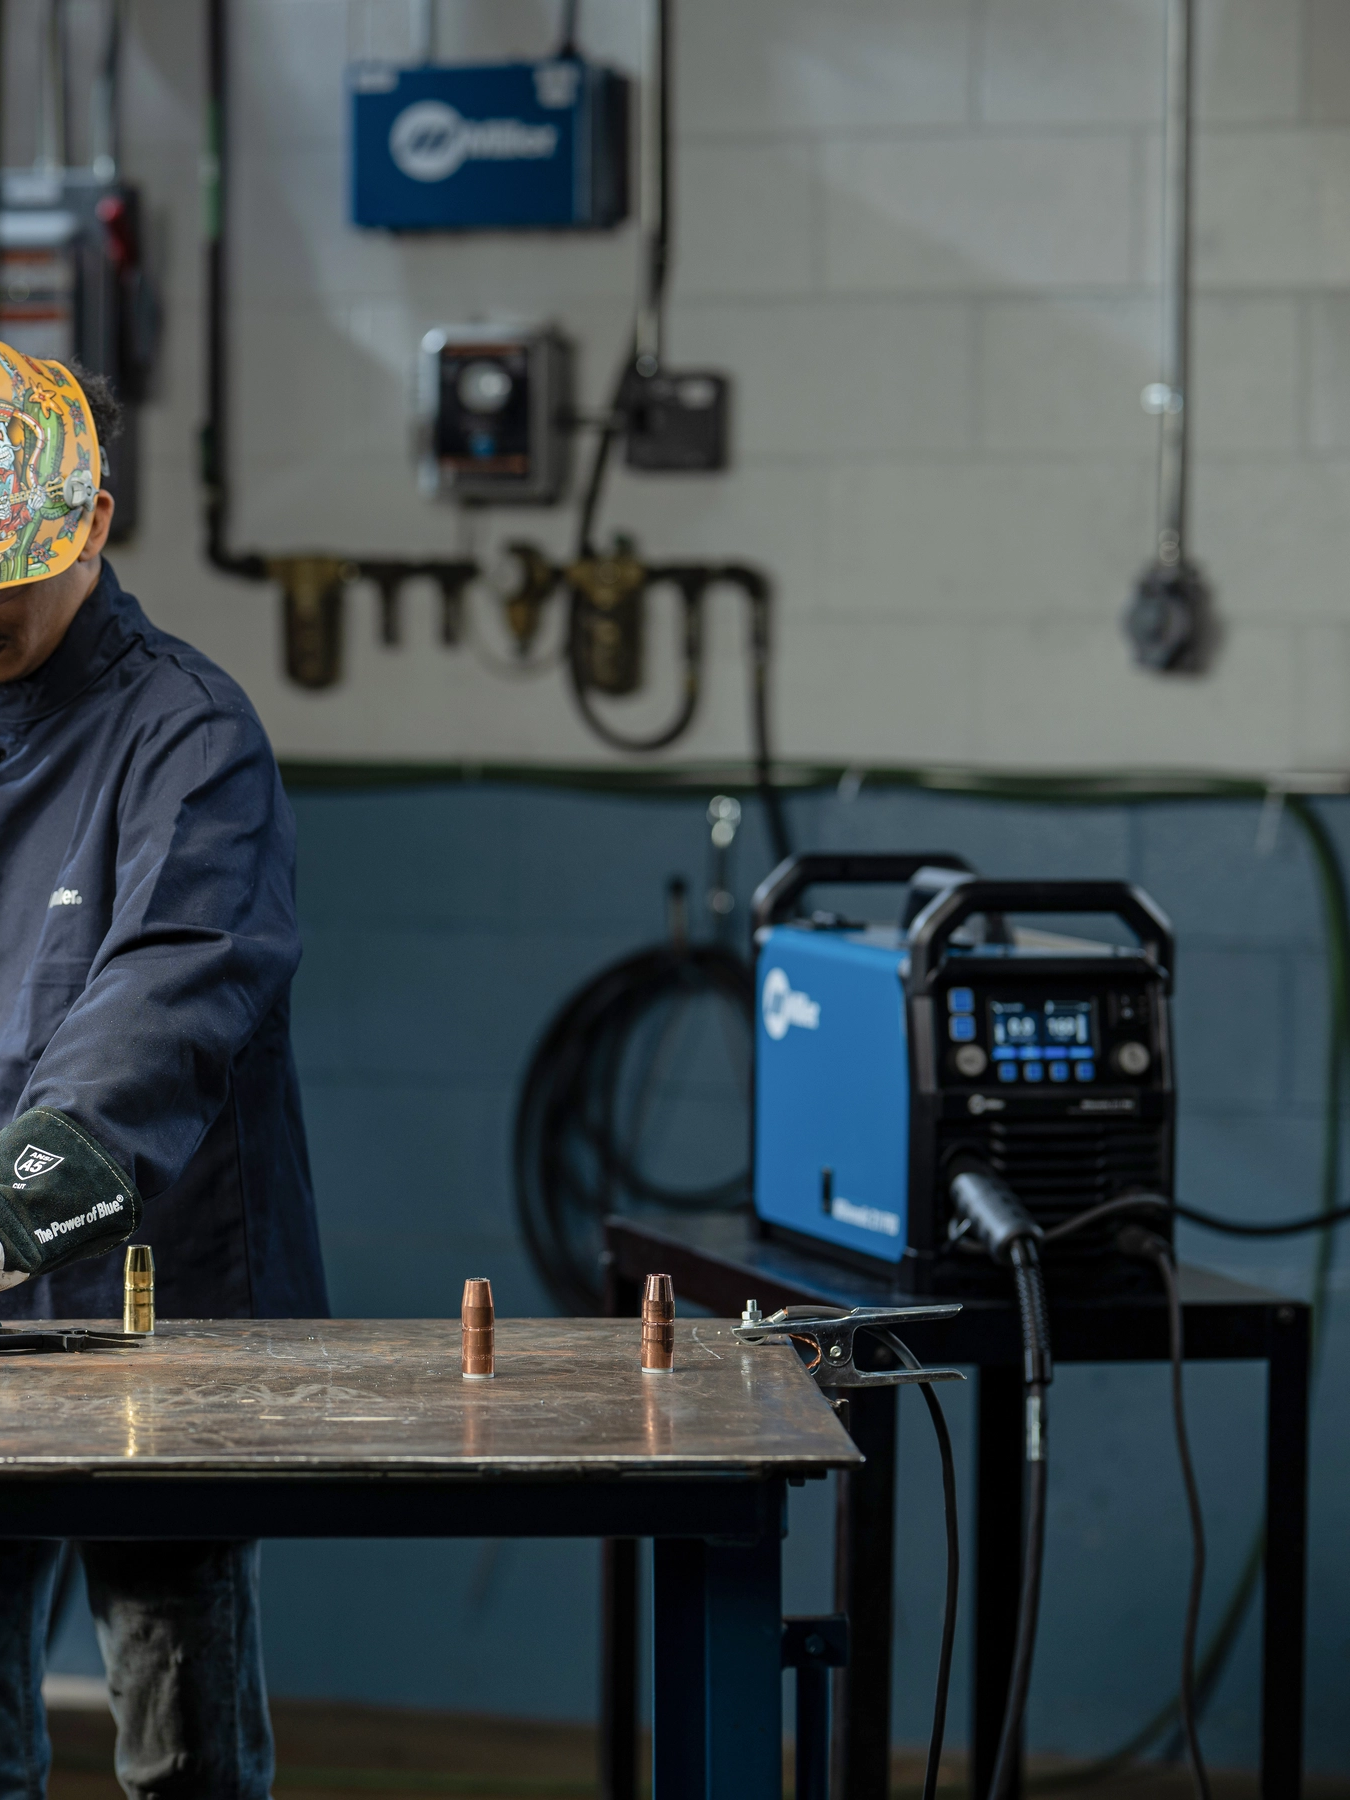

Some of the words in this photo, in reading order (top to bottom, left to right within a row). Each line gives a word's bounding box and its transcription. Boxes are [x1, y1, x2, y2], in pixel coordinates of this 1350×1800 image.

[30, 1152, 54, 1162] ANSI
[18, 1159, 47, 1173] A5
[34, 1228, 54, 1244] The
[50, 1214, 85, 1237] Power
[86, 1206, 97, 1223] of
